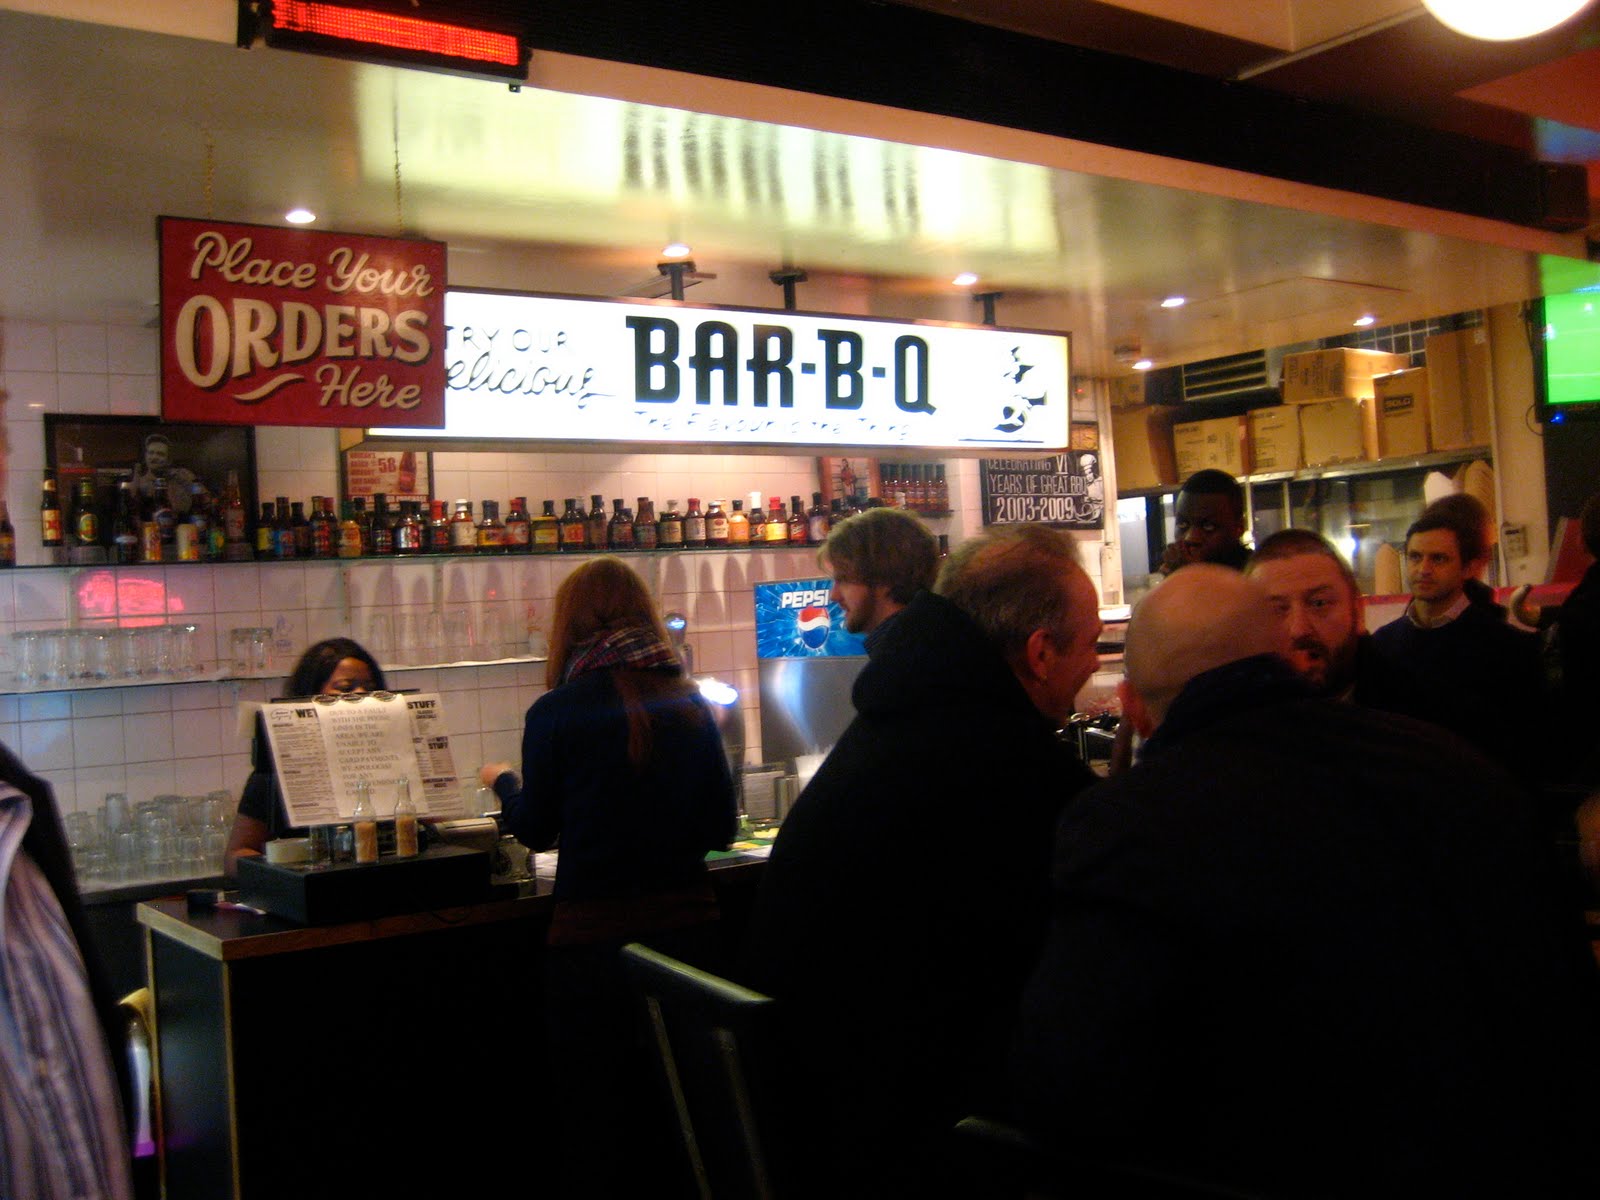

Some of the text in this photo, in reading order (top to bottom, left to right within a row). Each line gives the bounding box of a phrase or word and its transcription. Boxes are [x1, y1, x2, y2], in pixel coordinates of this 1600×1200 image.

[190, 231, 434, 297] Place Your
[175, 294, 432, 389] ORDERS
[315, 363, 421, 409] Here
[445, 350, 616, 410] elicious
[625, 315, 937, 416] BAR-B-Q
[990, 474, 1022, 494] YEARS
[1026, 474, 1038, 494] OF
[1041, 474, 1068, 494] GREAT
[996, 497, 1074, 522] 2003-2009
[781, 589, 830, 609] PEPSI
[407, 700, 435, 709] STUFF
